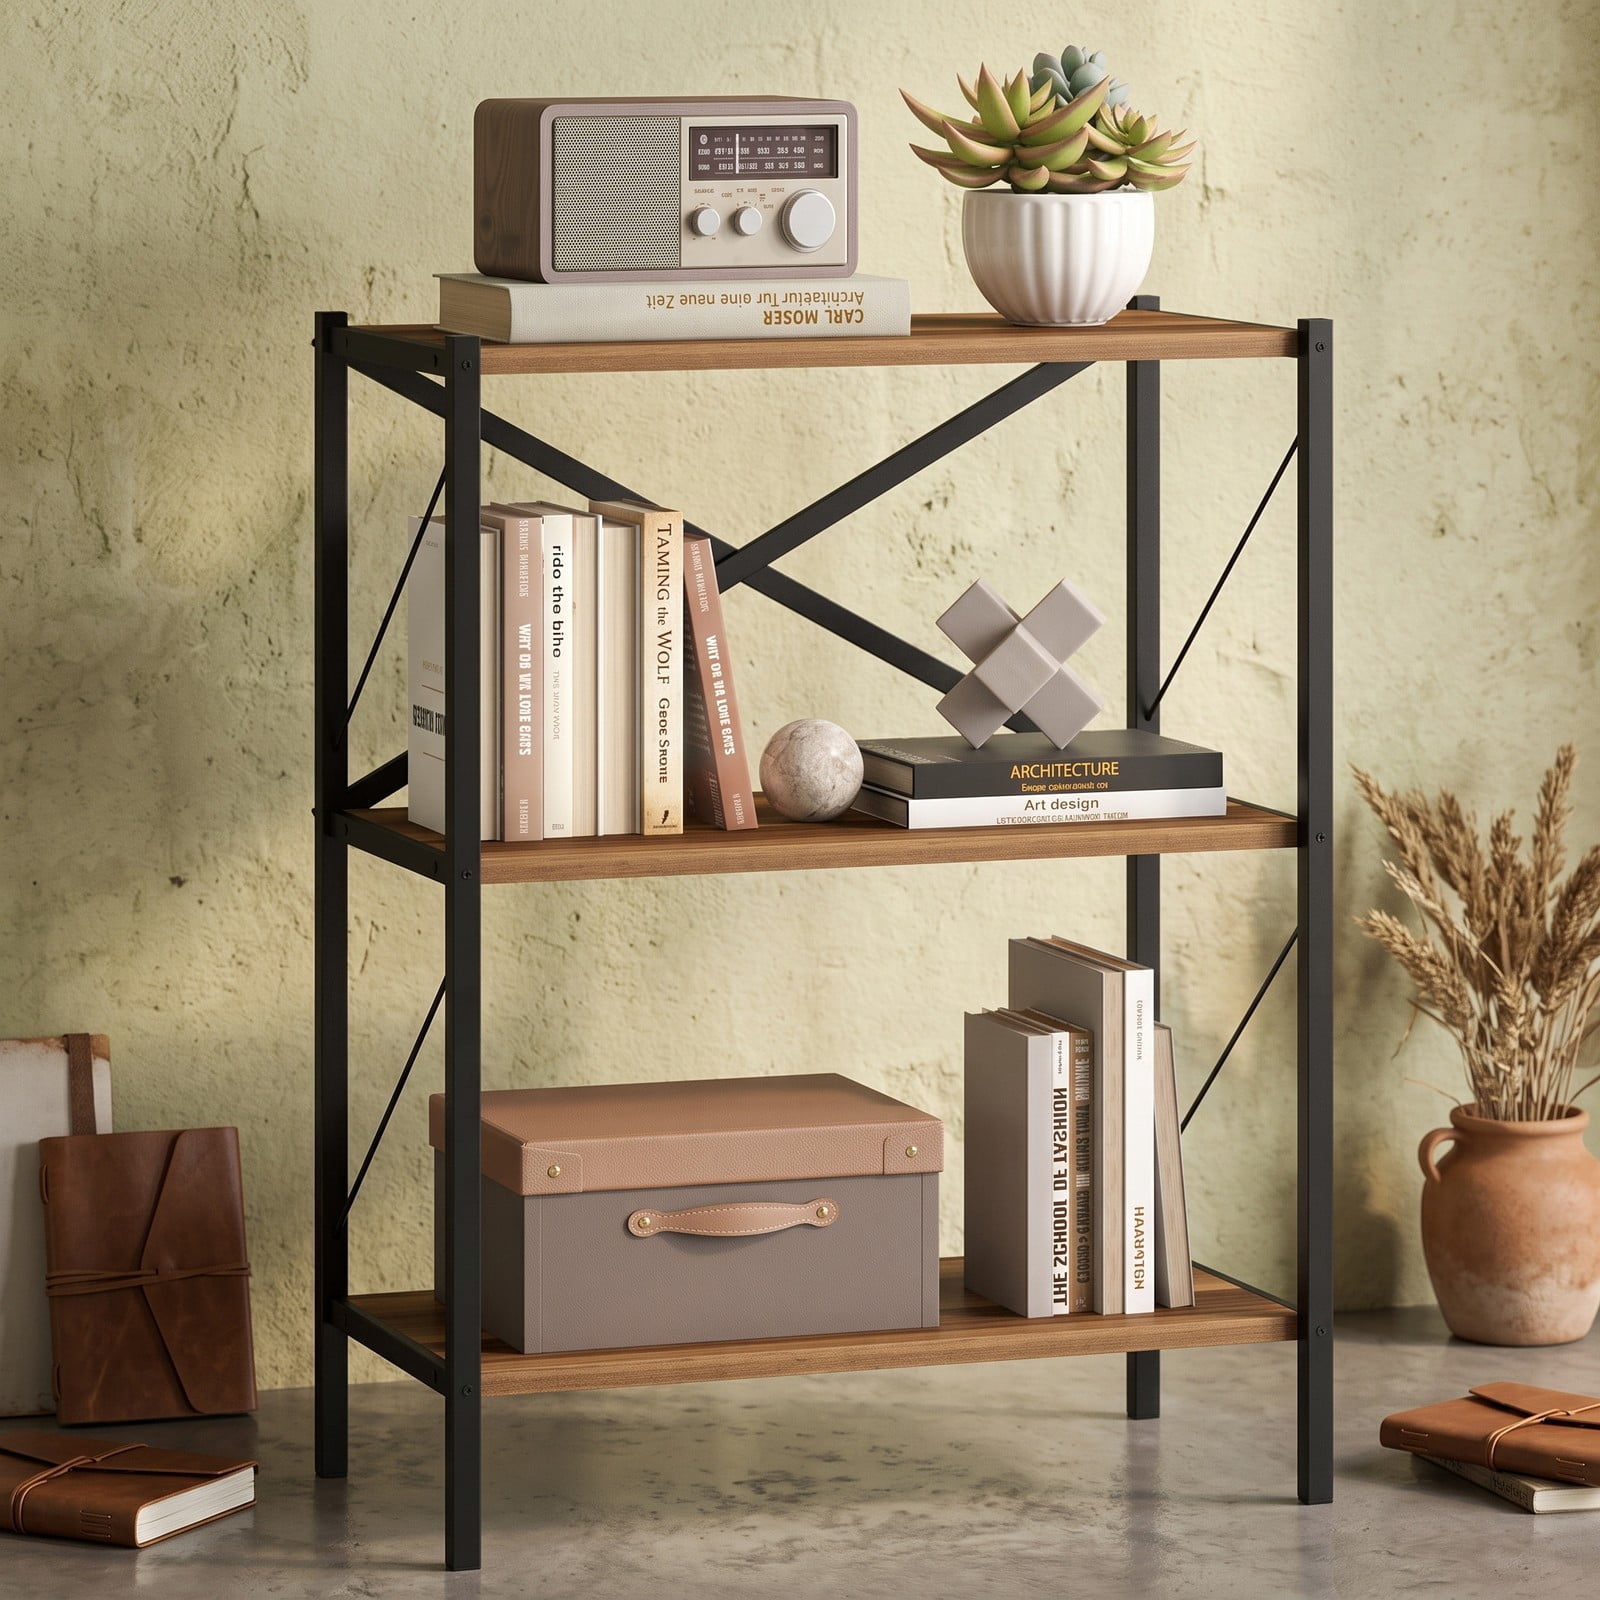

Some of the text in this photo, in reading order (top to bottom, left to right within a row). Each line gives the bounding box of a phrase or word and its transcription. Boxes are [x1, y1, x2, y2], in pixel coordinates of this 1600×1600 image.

[647, 295, 675, 310] Zeit
[764, 309, 864, 325] CARL MOSER
[552, 545, 564, 579] rido
[657, 523, 672, 601] TAMING
[657, 607, 669, 626] the
[657, 630, 672, 685] WOLF
[1010, 761, 1120, 779] ARCHITECTURE
[1024, 798, 1099, 812] Art design
